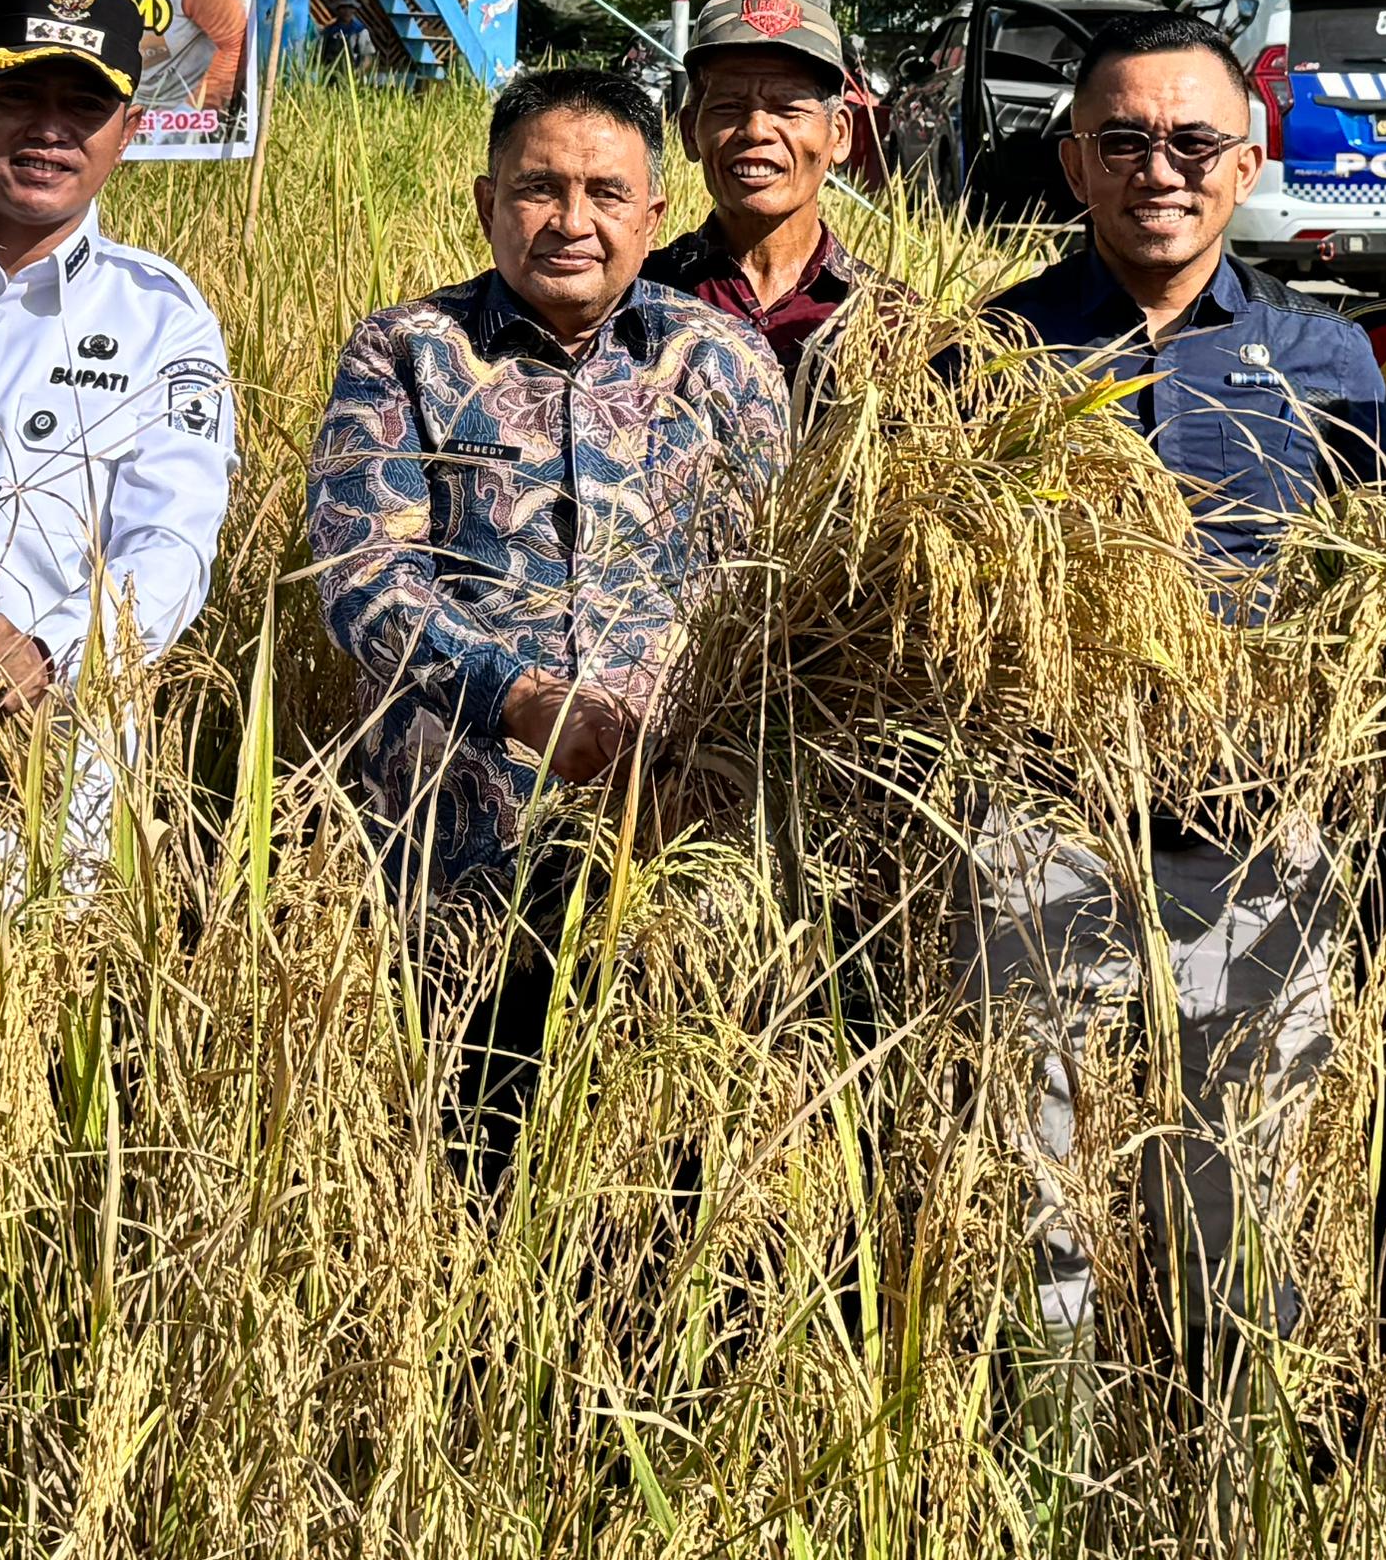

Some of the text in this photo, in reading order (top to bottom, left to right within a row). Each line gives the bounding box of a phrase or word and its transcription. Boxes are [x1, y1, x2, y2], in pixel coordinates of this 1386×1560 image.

[161, 113, 216, 130] 2025
[49, 366, 129, 393] BUPATI
[457, 443, 504, 456] KENEDY
